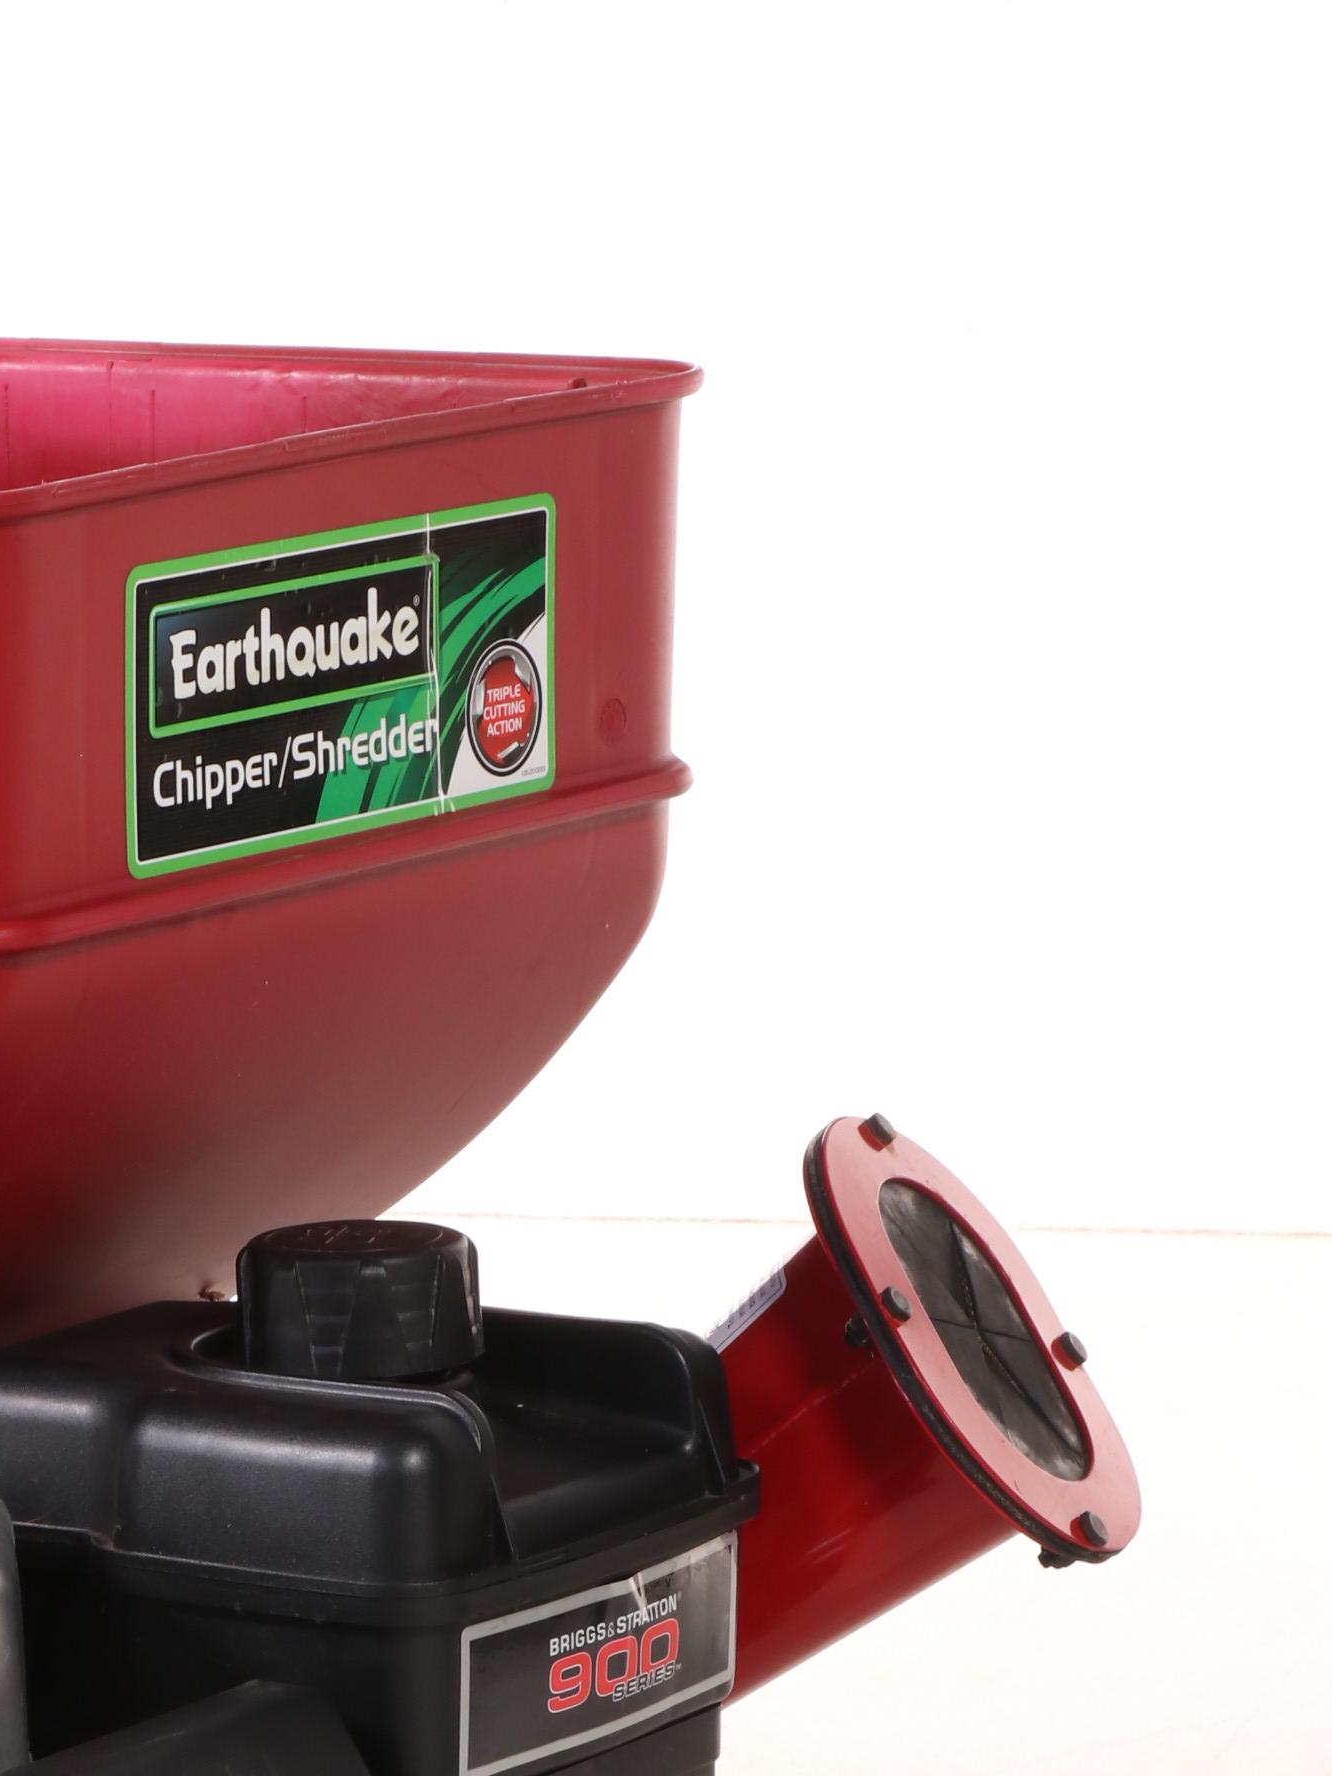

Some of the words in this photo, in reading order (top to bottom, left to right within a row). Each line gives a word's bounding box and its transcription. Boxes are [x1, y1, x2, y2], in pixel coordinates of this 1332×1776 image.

[169, 586, 420, 699] Earthquake
[483, 699, 526, 722] CUTTING
[486, 683, 522, 702] TRIPLE
[486, 718, 523, 738] ACTION
[153, 713, 439, 810] Chipper/Shredder
[547, 1617, 680, 1714] 900
[611, 1660, 676, 1703] SERIES
